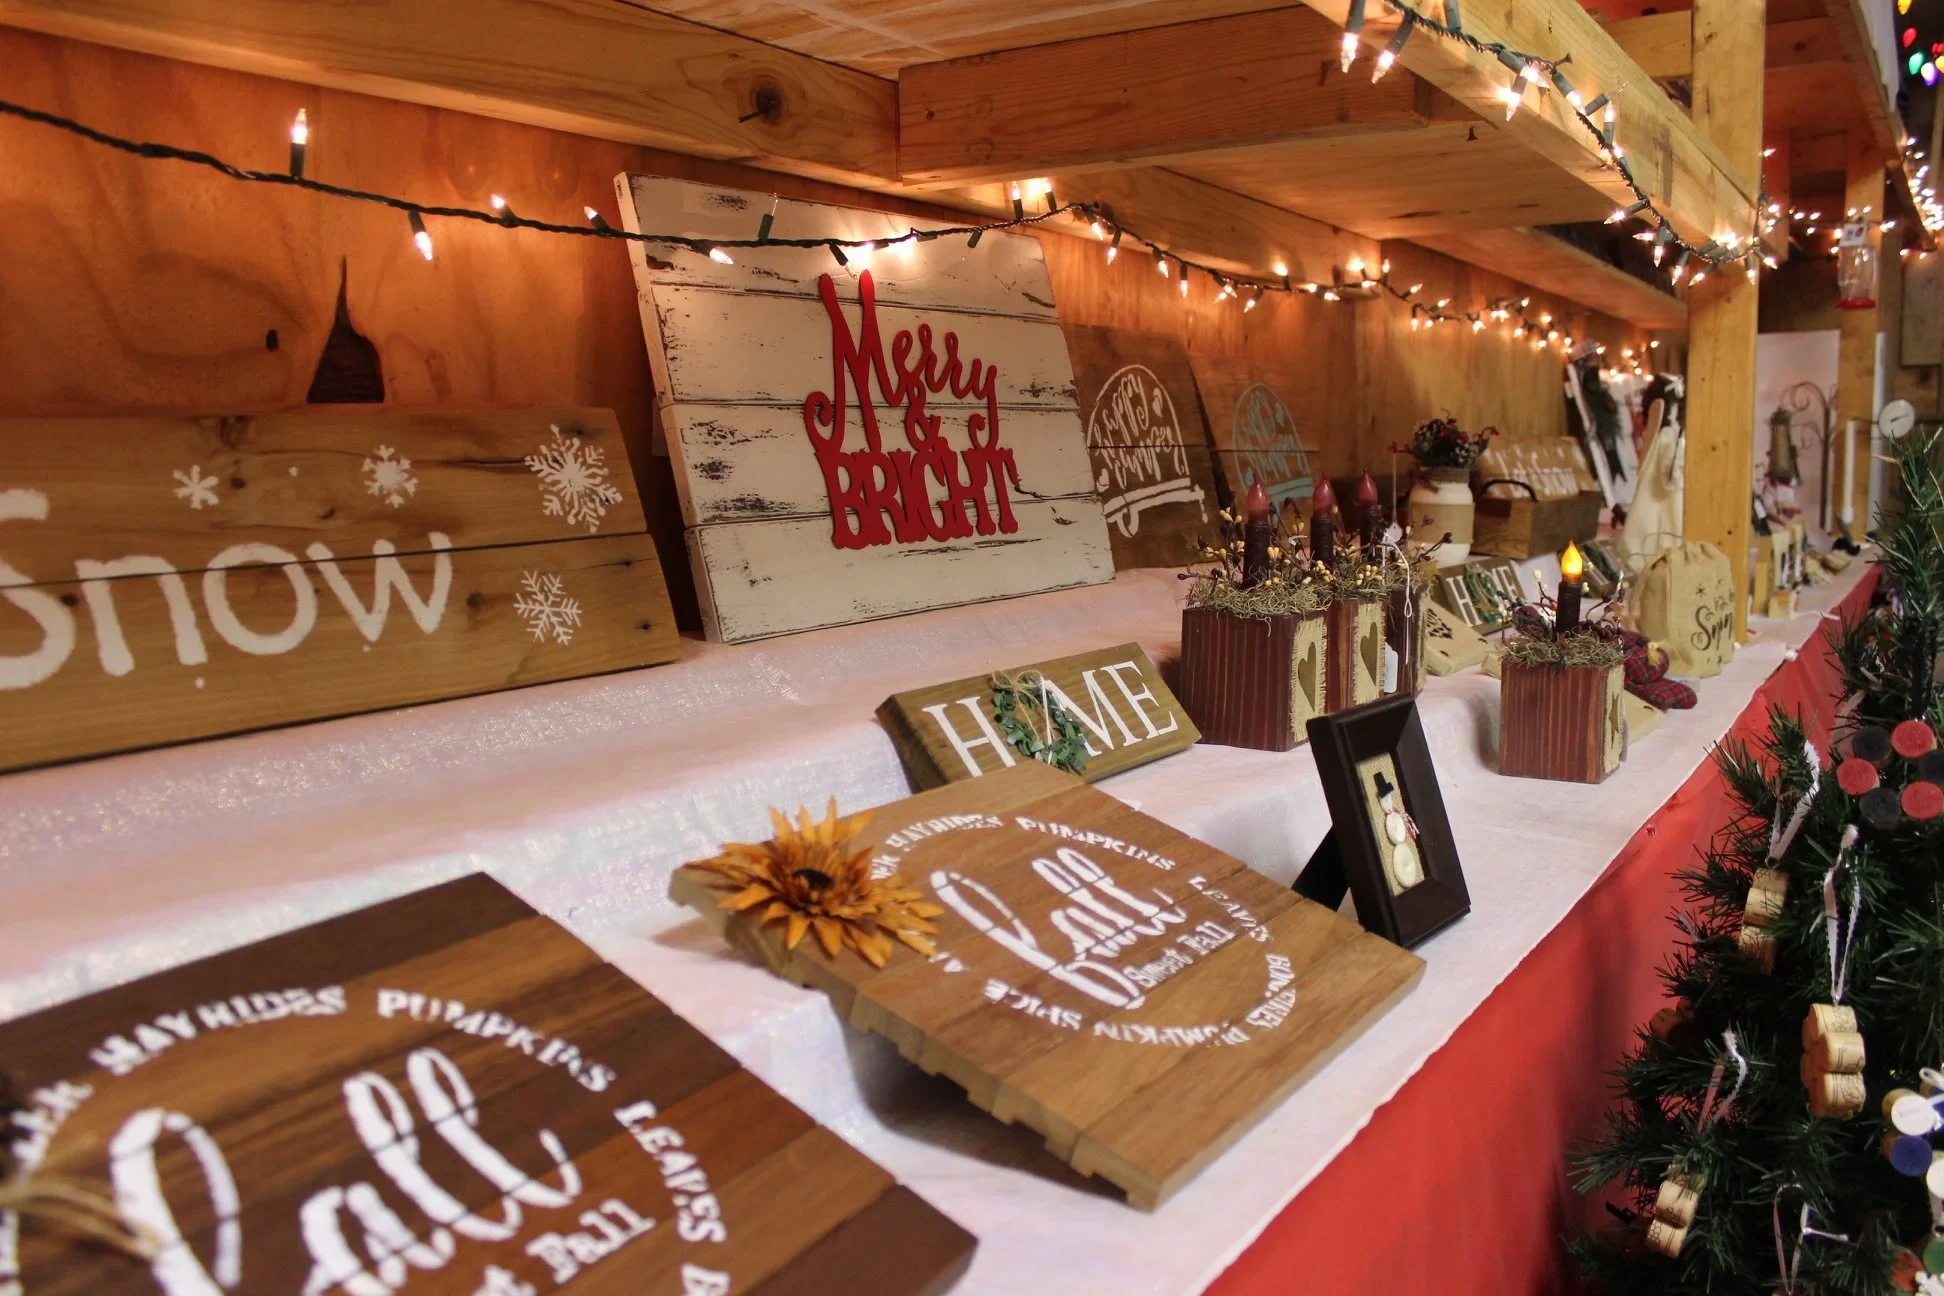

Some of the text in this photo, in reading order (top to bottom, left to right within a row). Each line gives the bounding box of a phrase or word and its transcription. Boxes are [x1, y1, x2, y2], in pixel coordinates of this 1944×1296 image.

[803, 269, 999, 452] Merry
[814, 447, 1018, 549] BRIGHT
[1015, 816, 1175, 871] PUMPKINS
[1122, 920, 1237, 989] Sweet Fall
[89, 984, 728, 1243] HAYRIDES PUMPKINS LEAVES
[525, 1198, 656, 1285] Fall
